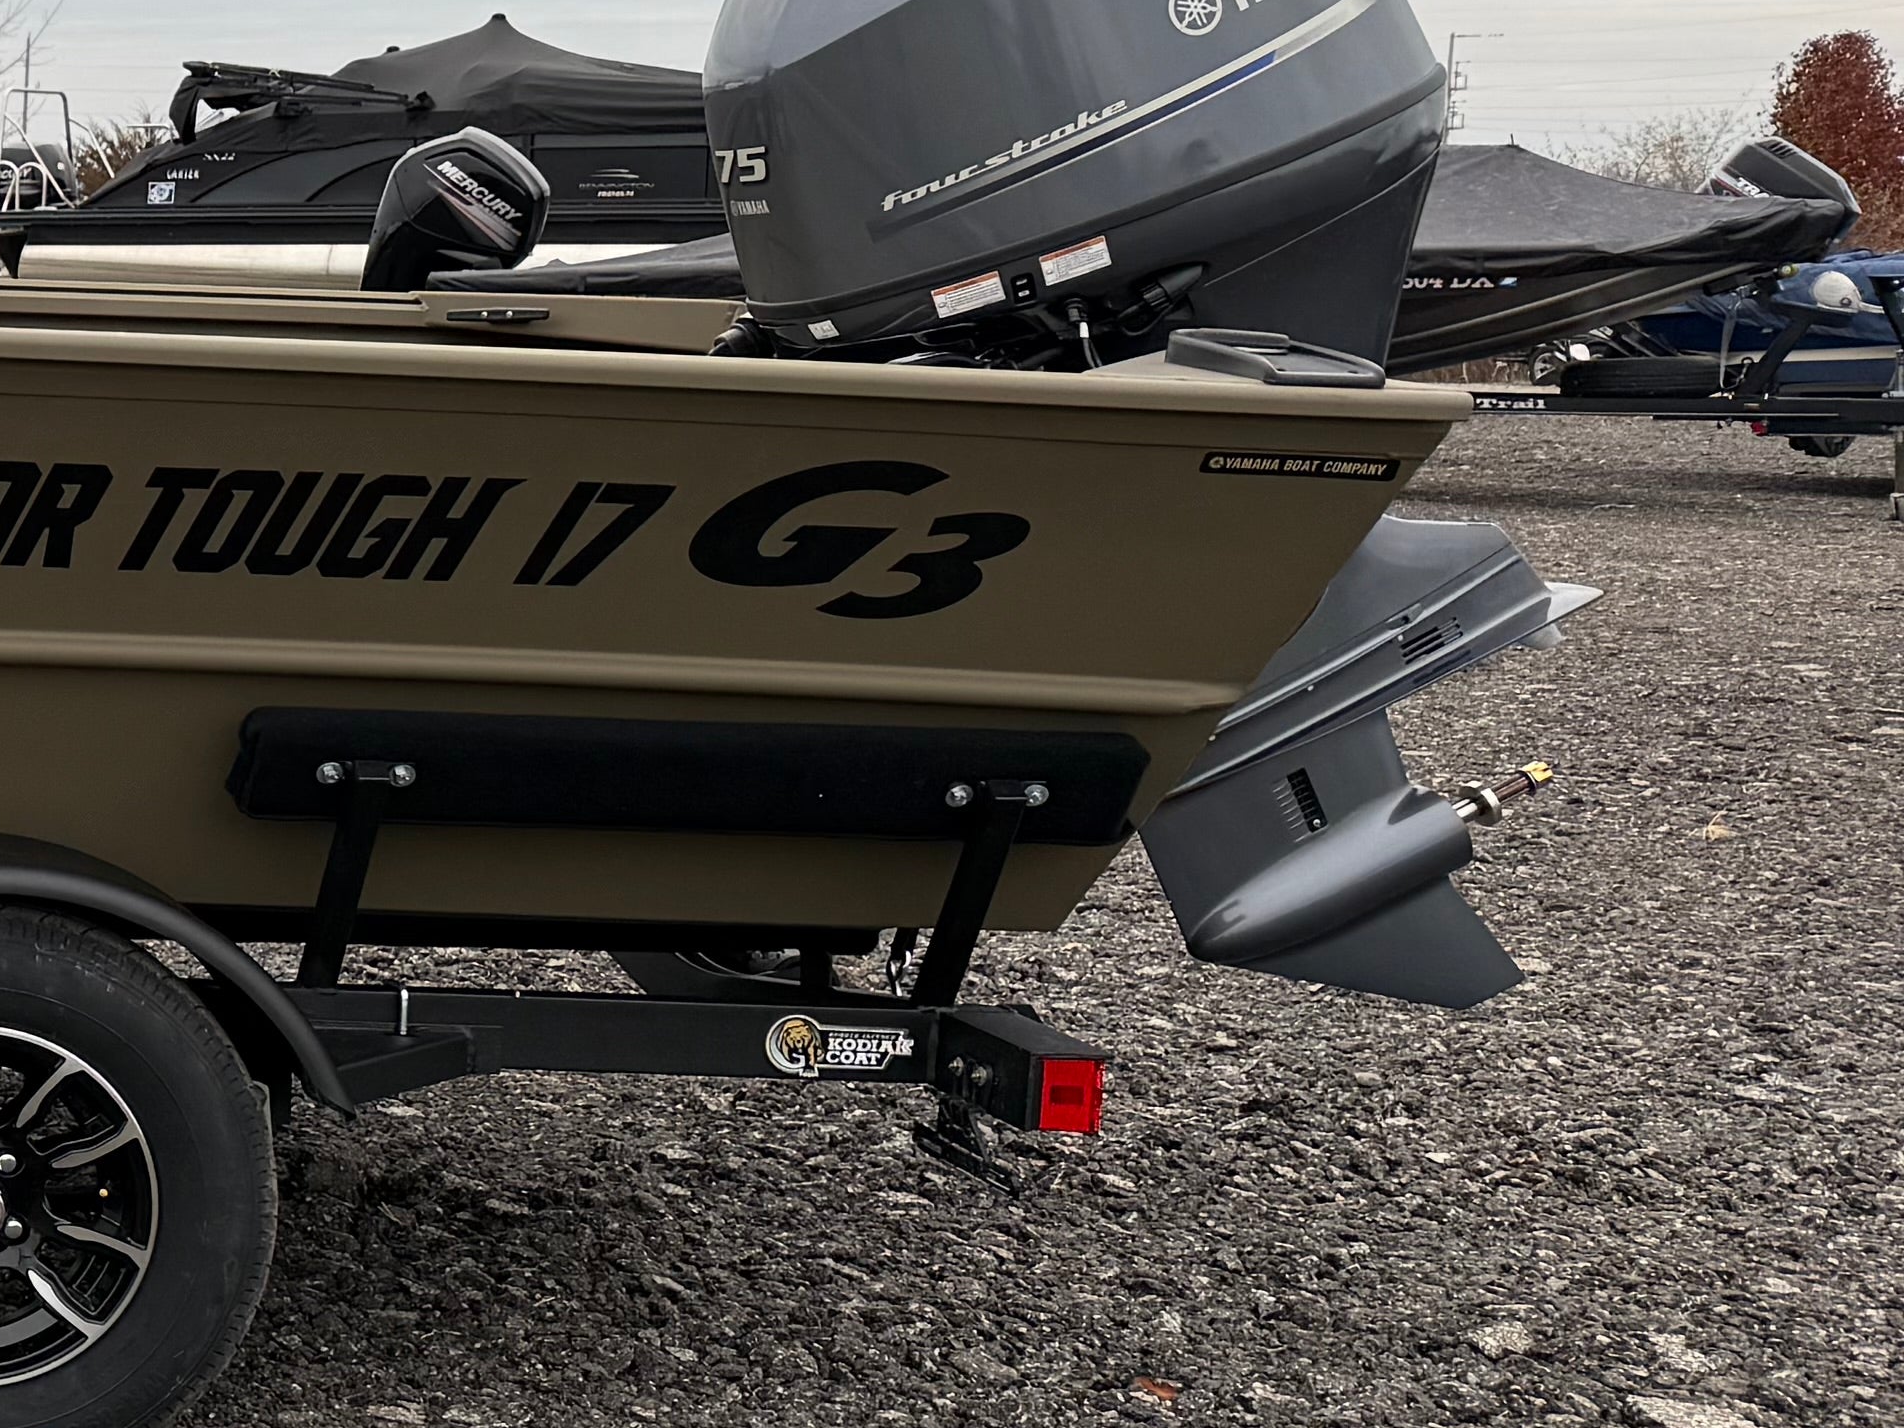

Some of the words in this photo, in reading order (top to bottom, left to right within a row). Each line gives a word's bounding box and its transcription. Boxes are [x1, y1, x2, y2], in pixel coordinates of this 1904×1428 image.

[714, 145, 766, 183] 75
[437, 160, 523, 220] MERCURY
[1225, 457, 1279, 470] YAMAHA
[1283, 459, 1321, 472] BOAT
[1323, 461, 1387, 476] COMPANY
[117, 466, 528, 582] TOUGH
[513, 481, 677, 587] 17
[688, 460, 1031, 620] G3
[826, 1051, 881, 1065] COAT
[828, 1038, 914, 1056] KODIAK
